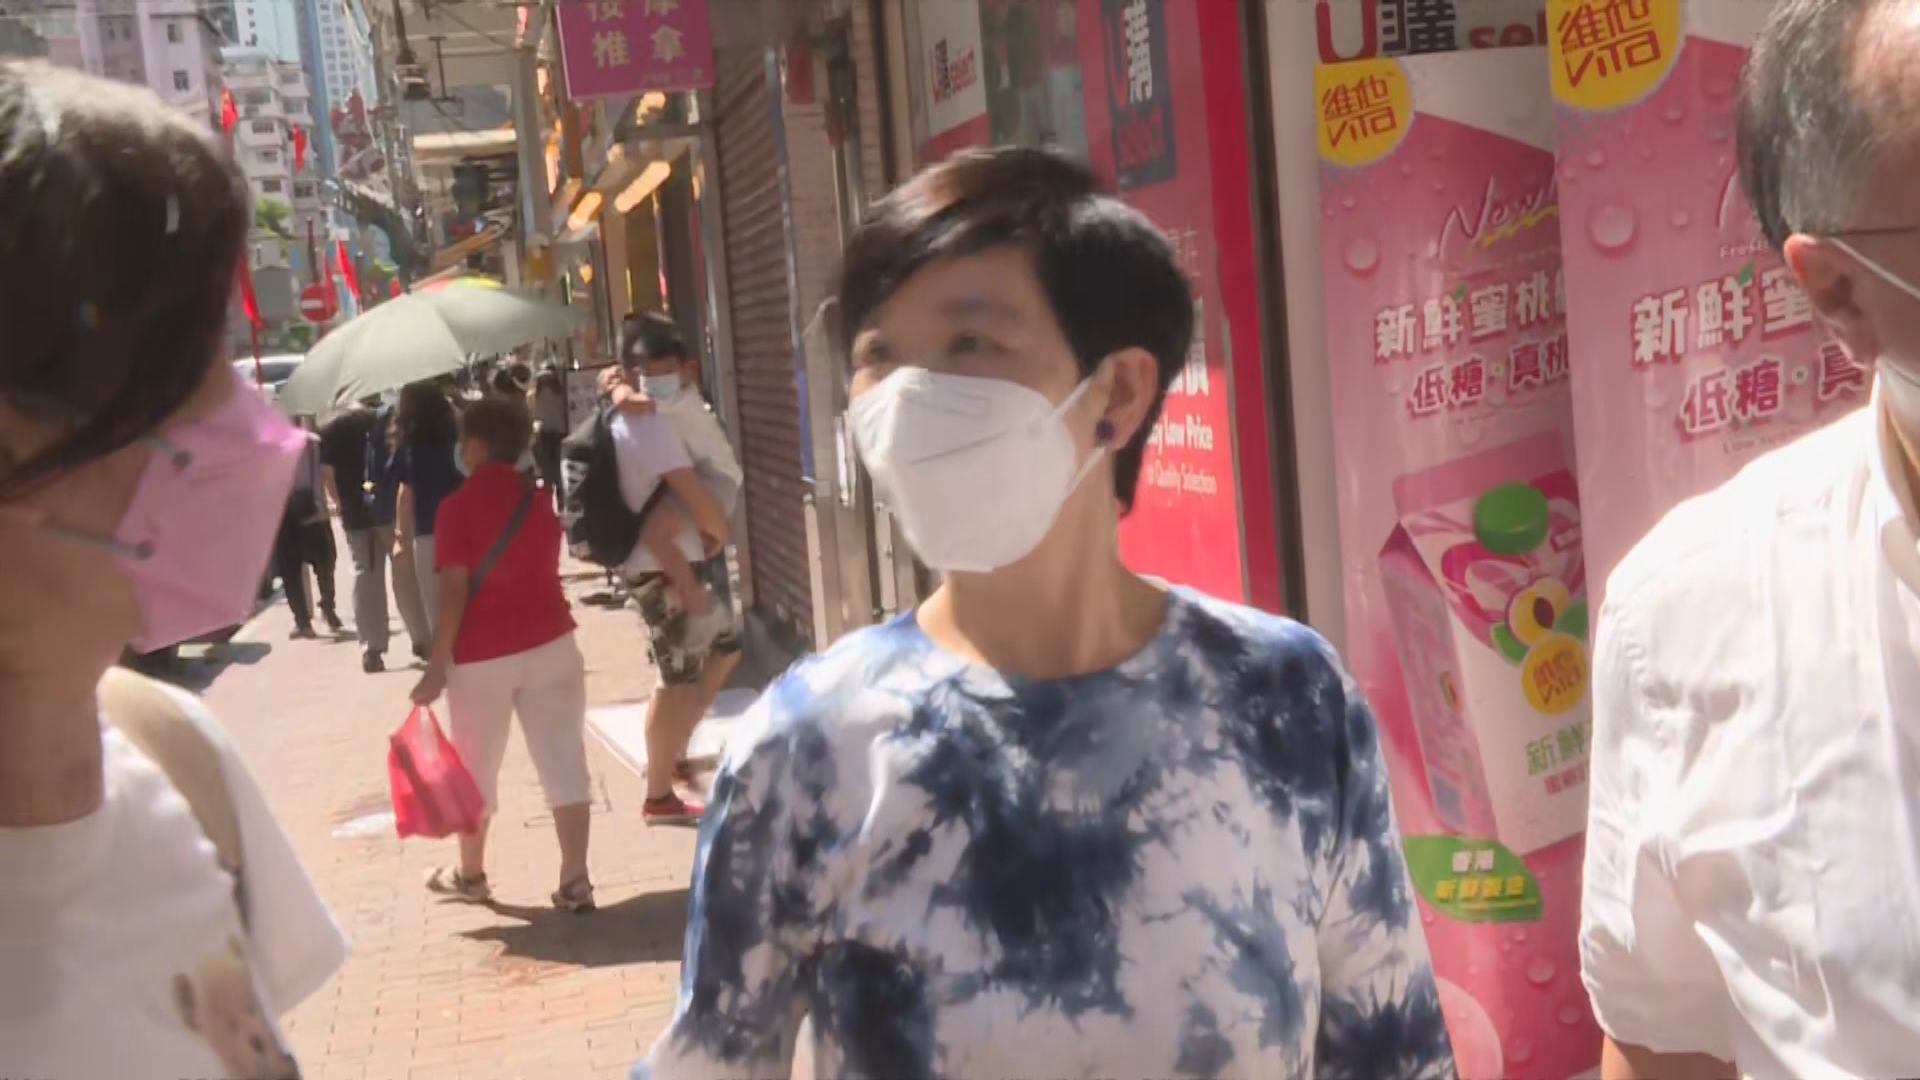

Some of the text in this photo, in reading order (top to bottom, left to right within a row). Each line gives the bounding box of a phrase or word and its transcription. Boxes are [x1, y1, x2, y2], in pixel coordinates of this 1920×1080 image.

[592, 25, 685, 67] 推拿
[1633, 266, 1814, 363] 新鮮蜜
[1525, 718, 1592, 776] 新鮮
